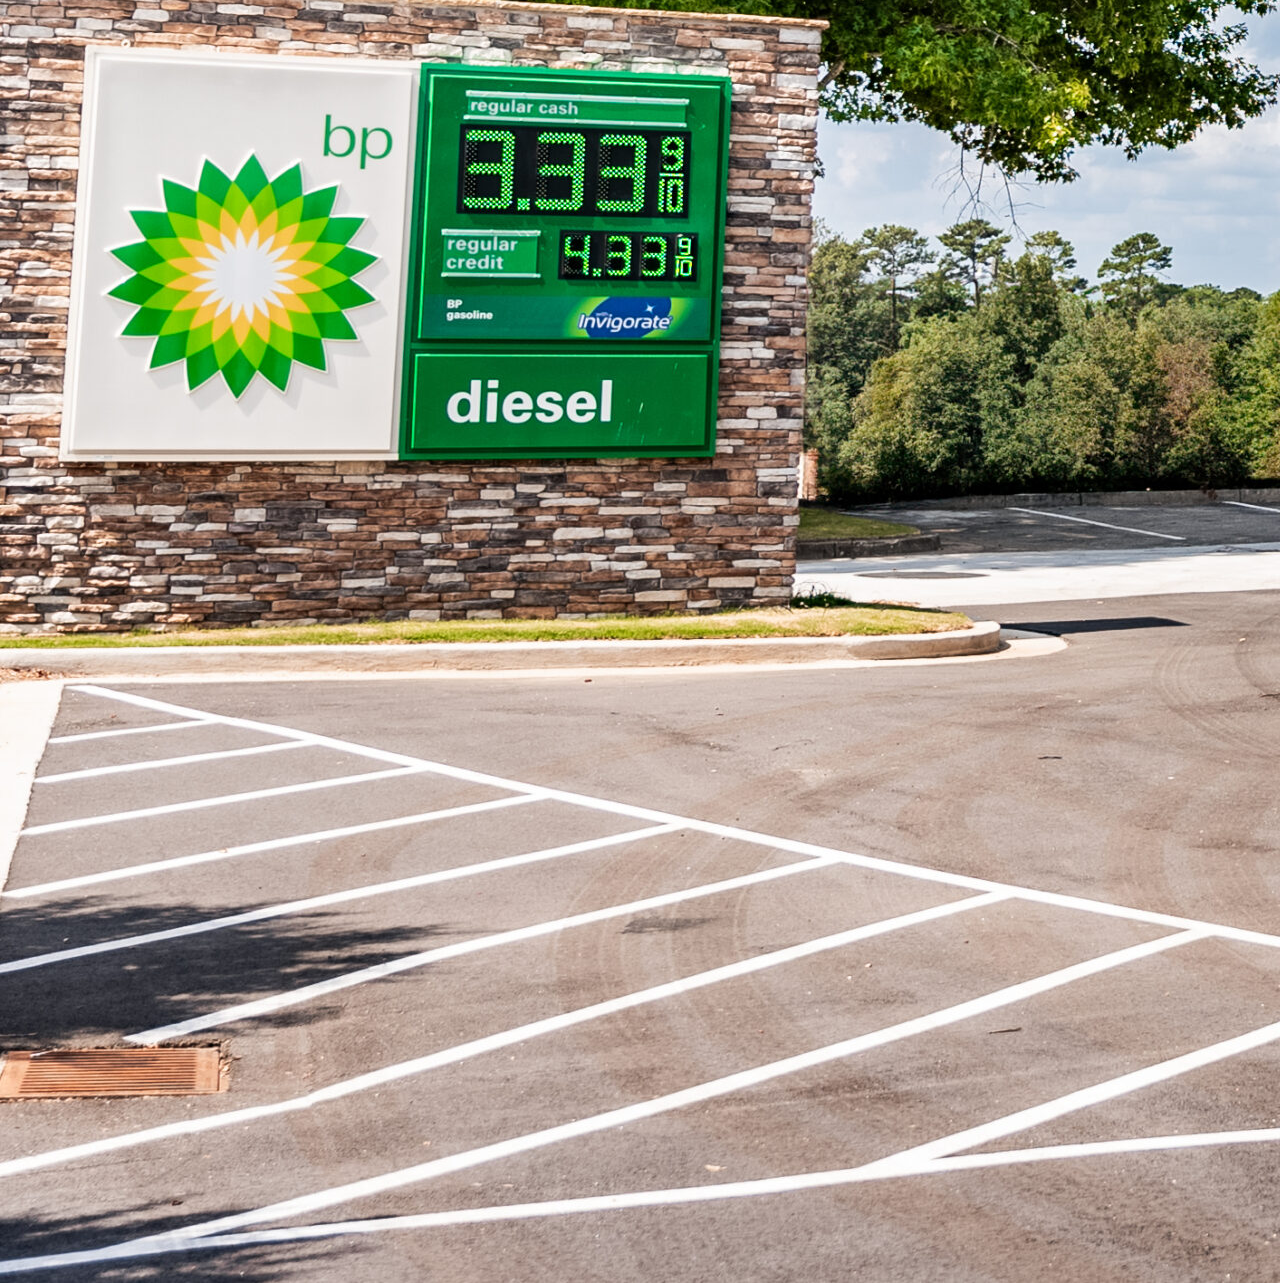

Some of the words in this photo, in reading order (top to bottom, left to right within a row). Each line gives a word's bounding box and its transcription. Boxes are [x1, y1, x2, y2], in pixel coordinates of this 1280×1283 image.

[470, 99, 533, 115] regular
[539, 102, 578, 115] cash
[323, 114, 393, 170] bp
[464, 129, 647, 212] 3.33
[447, 237, 518, 254] regular
[446, 255, 504, 270] credit
[564, 234, 667, 276] 4.33
[447, 299, 463, 309] BP
[446, 310, 494, 321] gasoline
[578, 314, 670, 333] Invigorate
[447, 379, 613, 424] diesel
